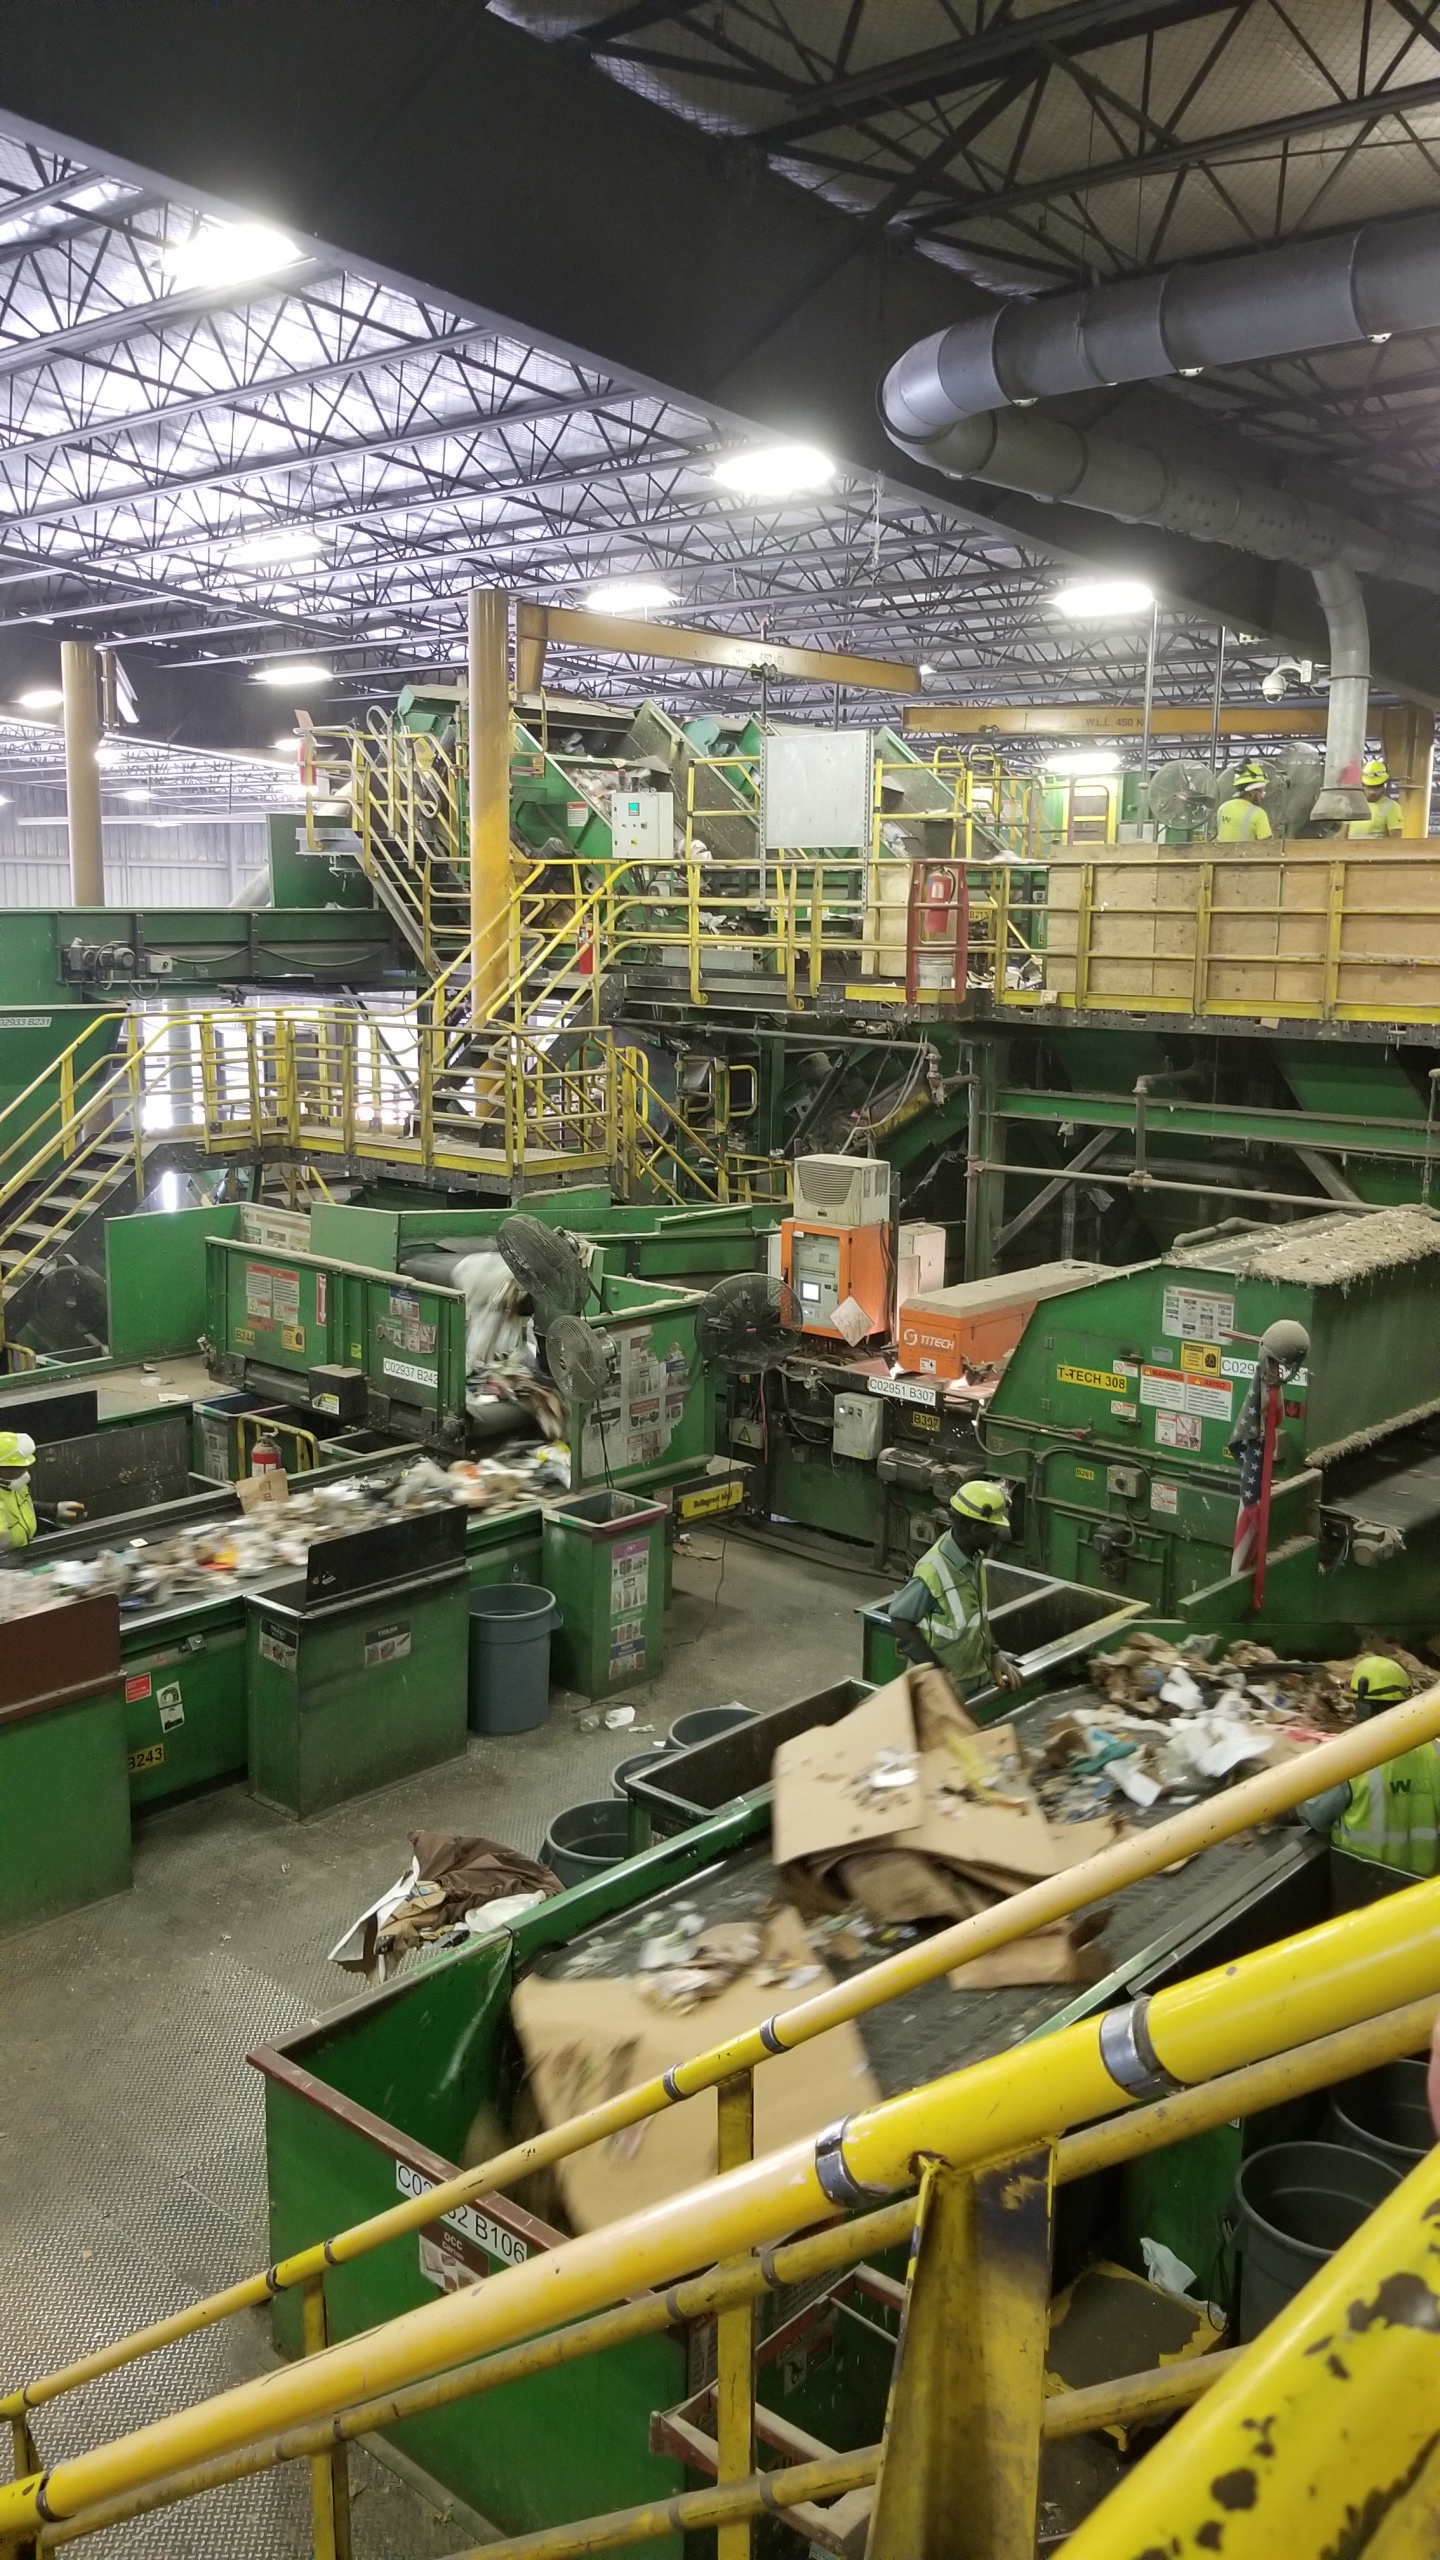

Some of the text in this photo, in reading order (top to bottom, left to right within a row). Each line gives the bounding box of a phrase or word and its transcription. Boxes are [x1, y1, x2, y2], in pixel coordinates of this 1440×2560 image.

[1115, 718, 1134, 727] 450
[920, 1334, 956, 1350] TITECH
[385, 1360, 415, 1378] C02937
[1151, 1369, 1183, 1381] WARNING
[1222, 1360, 1255, 1375] C029
[1105, 1375, 1125, 1390] 308
[1204, 1380, 1226, 1389] AVISO
[869, 1379, 935, 1402] C02951 B307
[914, 1413, 940, 1428] B307
[443, 2230, 464, 2251] OCC
[475, 2214, 526, 2265] B106
